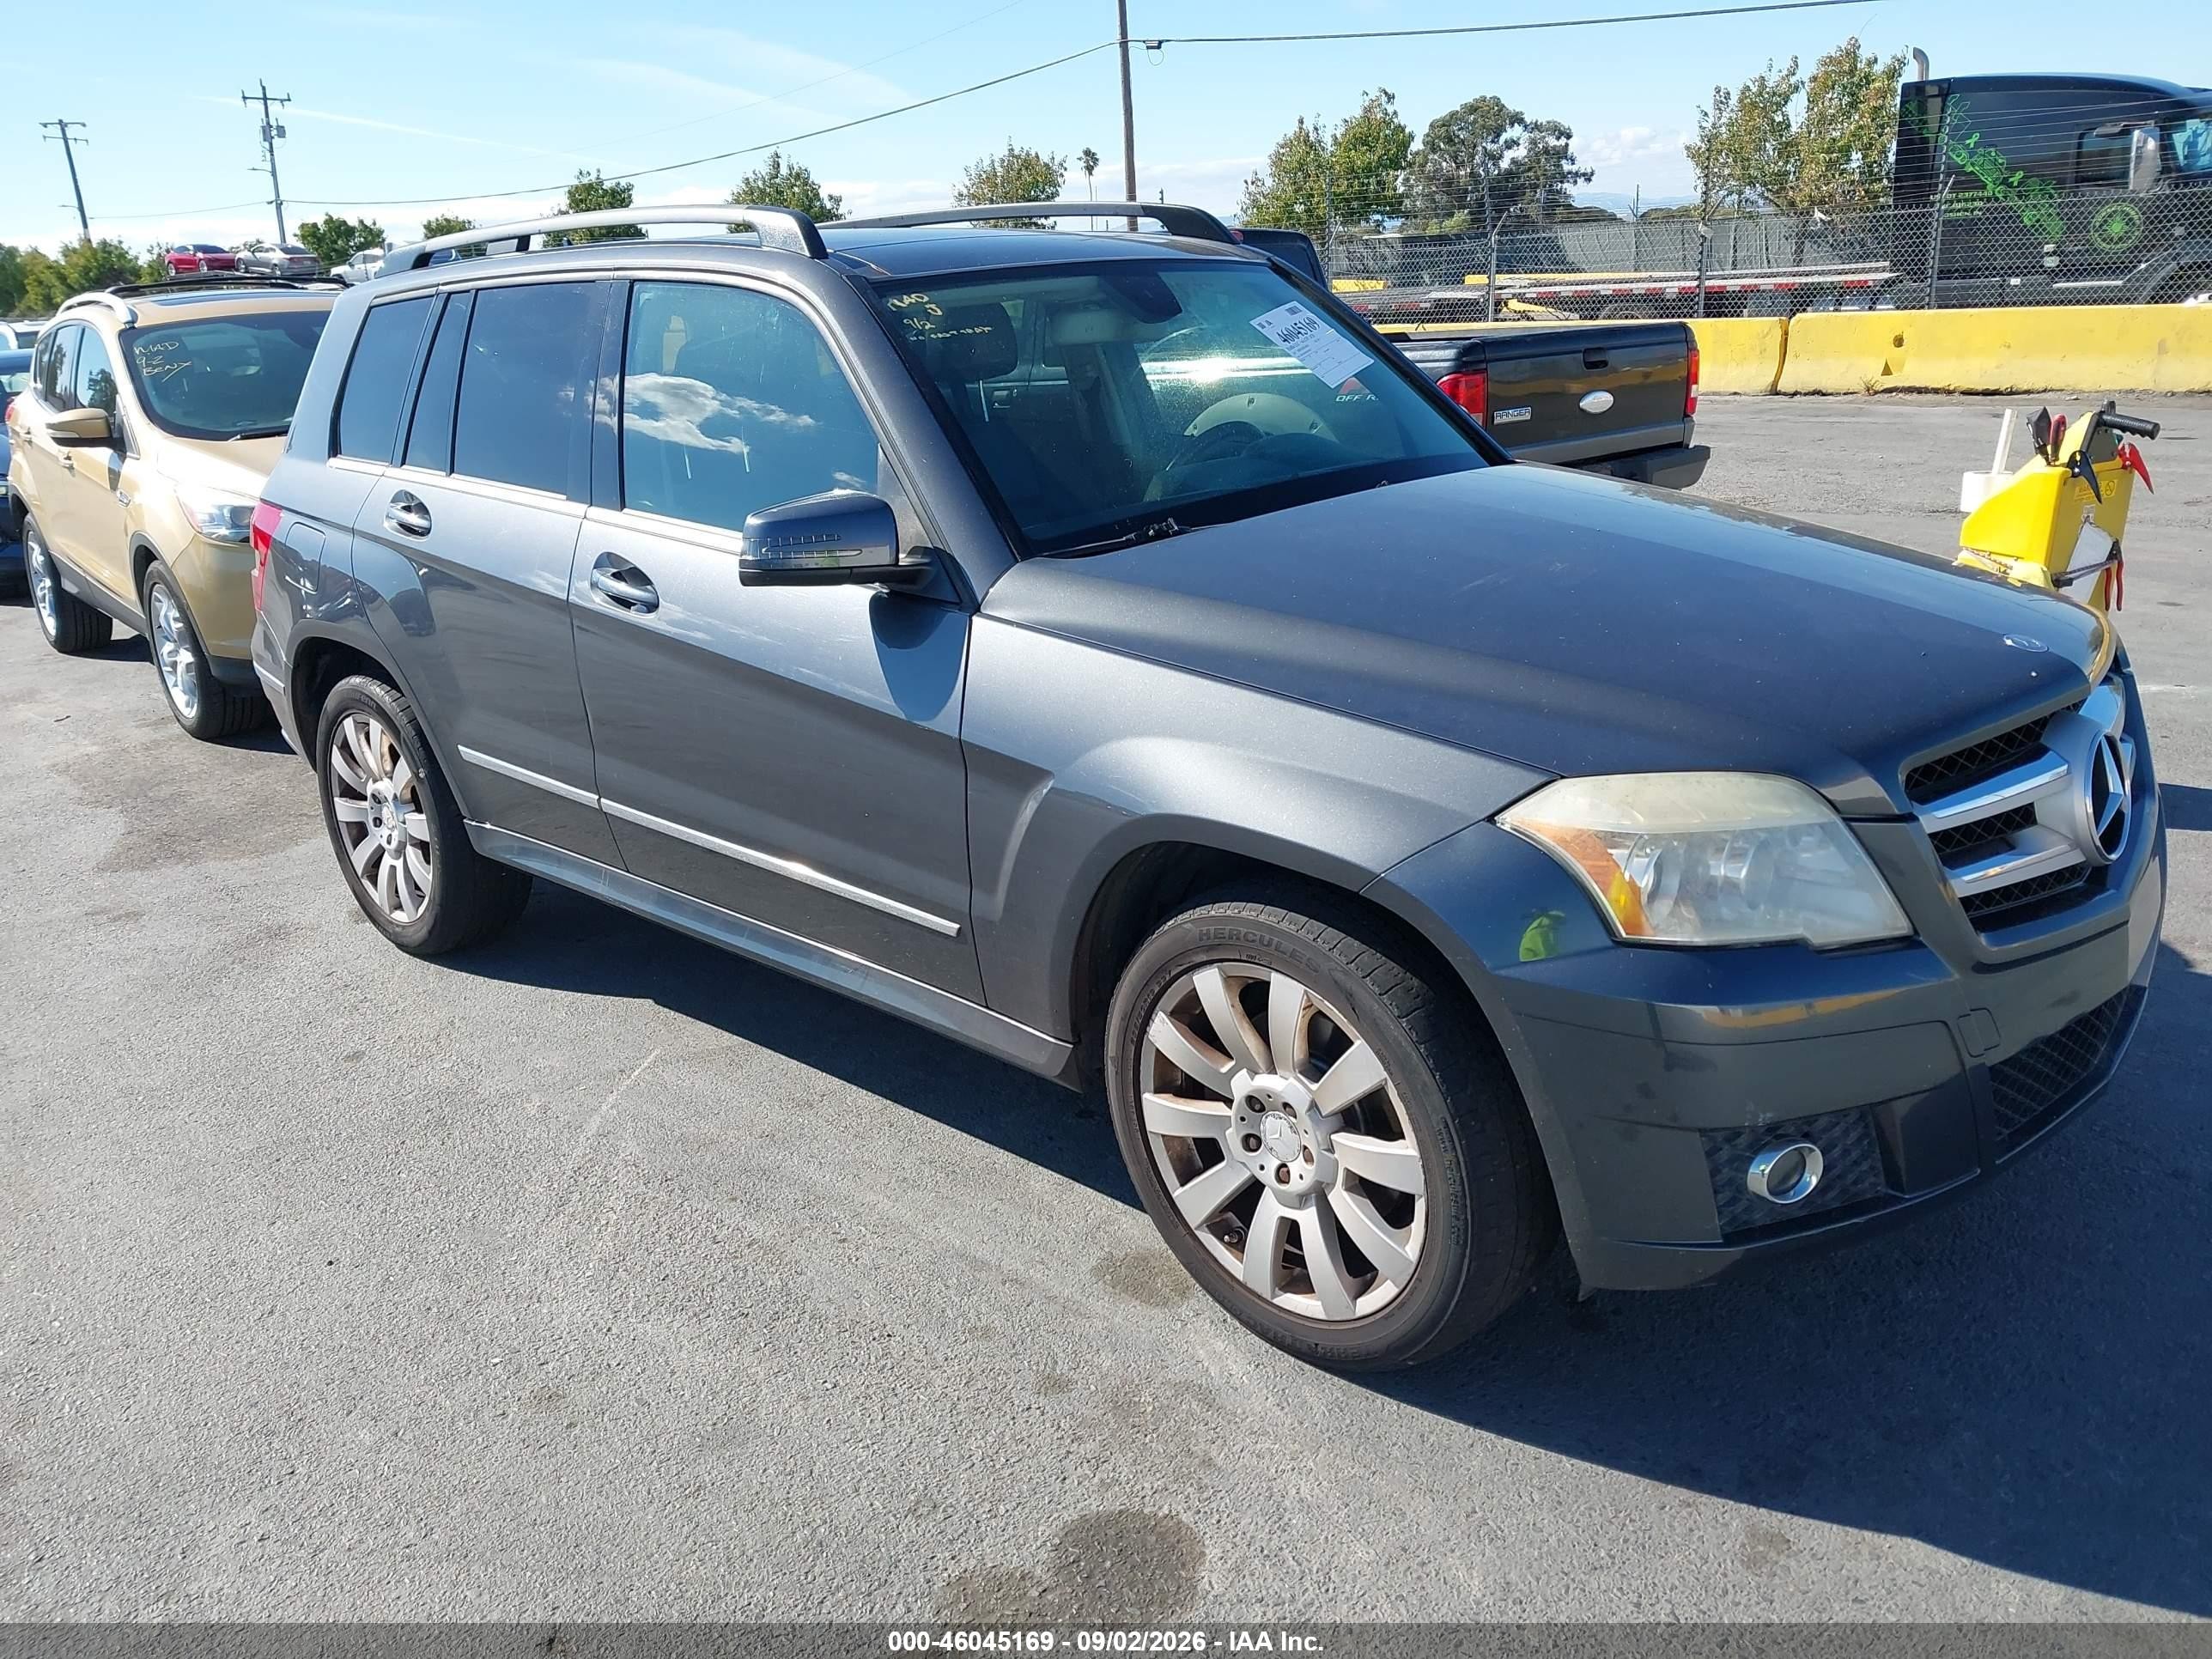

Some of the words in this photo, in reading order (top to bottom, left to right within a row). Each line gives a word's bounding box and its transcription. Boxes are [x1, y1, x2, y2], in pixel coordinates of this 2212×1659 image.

[903, 318, 937, 331] 9/2
[1276, 316, 1321, 344] 46045169
[1495, 408, 1530, 420] RANGER
[1197, 926, 1321, 975] HERCULES
